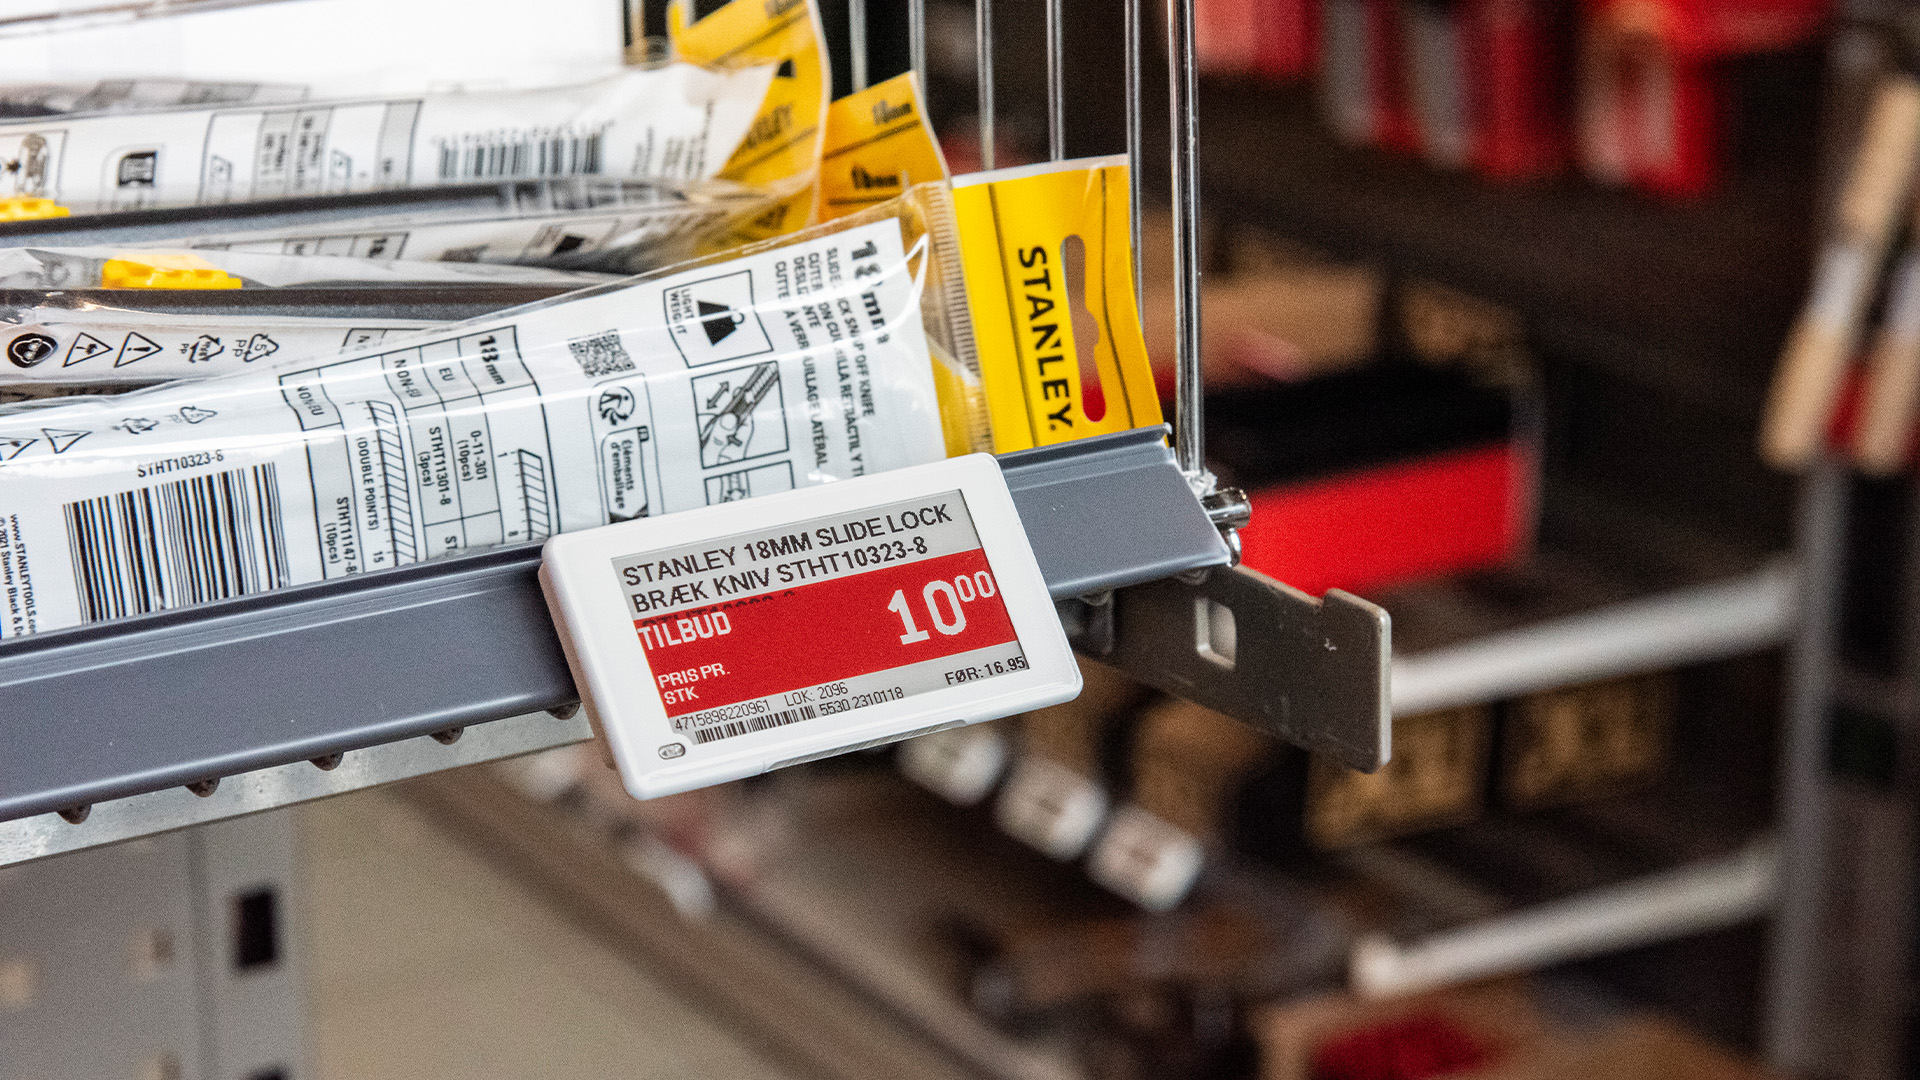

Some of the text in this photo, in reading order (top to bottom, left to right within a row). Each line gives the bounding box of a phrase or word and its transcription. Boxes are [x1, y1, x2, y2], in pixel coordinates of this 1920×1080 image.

[681, 288, 695, 319] LIGHT
[775, 261, 790, 299] CUTTE
[790, 320, 821, 410] VERRUILLAGE
[394, 359, 423, 398] NON-EU
[438, 367, 455, 382] EU
[855, 355, 869, 376] OFF
[826, 322, 850, 382] CUILLA
[851, 453, 862, 462] Y
[860, 380, 875, 417] KNIFE
[136, 449, 225, 478] STHT10323-8
[417, 451, 435, 488] (3pcs)
[429, 426, 451, 506] STHT11301-8
[457, 439, 473, 482] (10pcs)
[470, 430, 488, 481] 0-11-301
[622, 439, 635, 491] Éléments
[356, 437, 380, 531] (DOUBLE POINTS)
[610, 442, 625, 509] d'emballage
[324, 522, 342, 564] (10pcs)
[373, 551, 385, 563] 15
[623, 503, 953, 587] STANLEY 18MM SLIDE LOCK
[1, 550, 14, 586] Stanley
[631, 581, 708, 613] BRÆK
[713, 567, 770, 597] KNIV
[776, 536, 928, 584] STHT10323-8
[7, 586, 20, 615] Black
[12, 616, 23, 625] &
[636, 611, 732, 651] TILBUD
[657, 663, 731, 689] PRIS PR.
[944, 656, 1026, 685] FØR: 16.95
[664, 687, 699, 705] STK
[674, 682, 849, 731] 4715898220961 LOK: 2096
[820, 687, 904, 716] 5530 2310118
